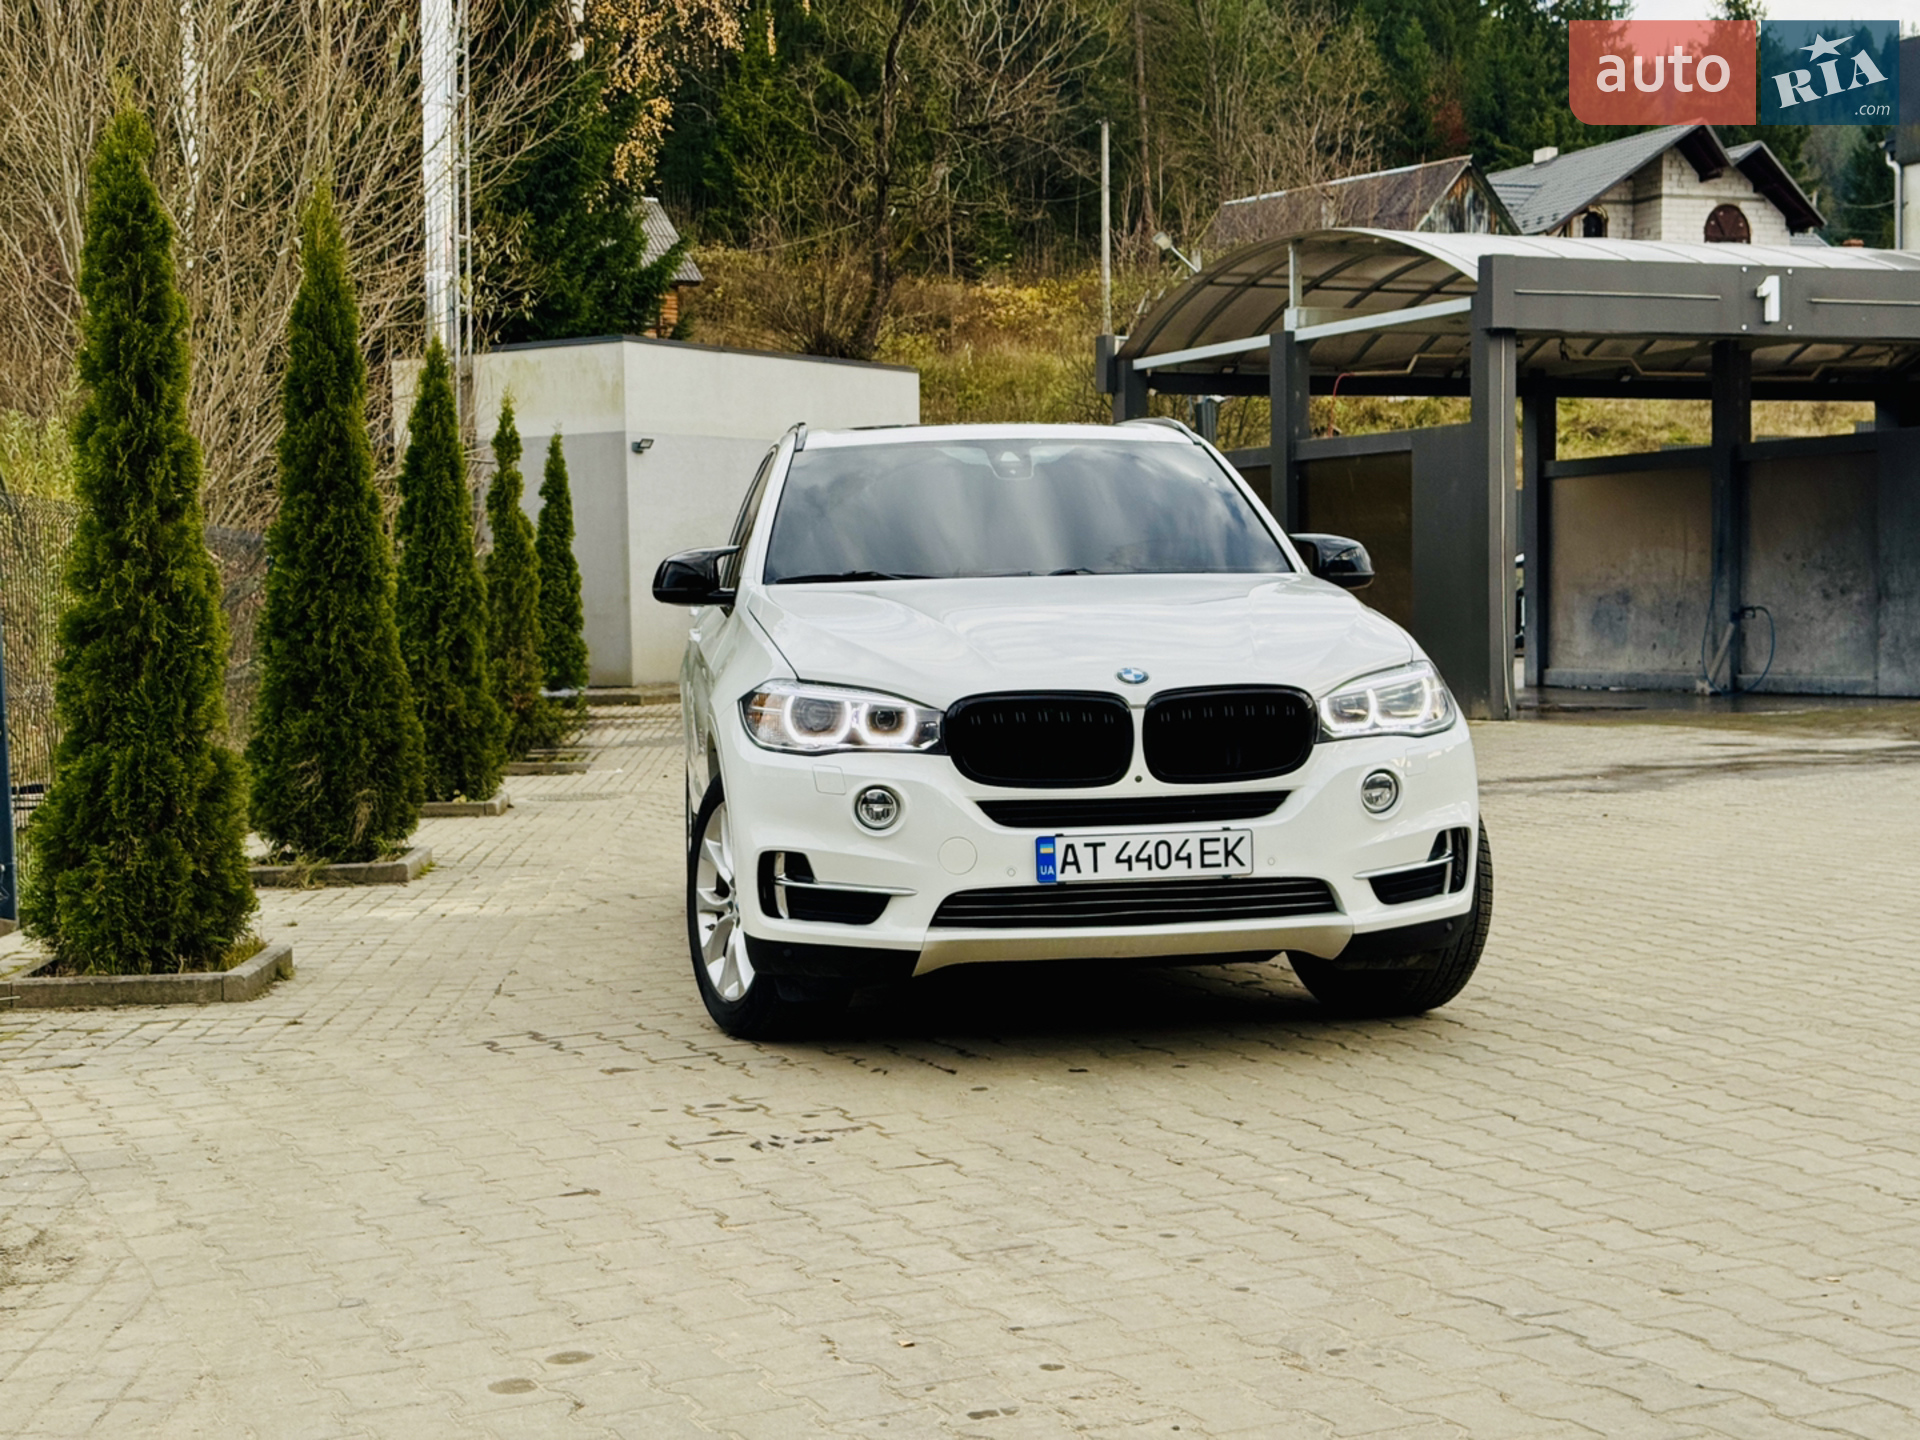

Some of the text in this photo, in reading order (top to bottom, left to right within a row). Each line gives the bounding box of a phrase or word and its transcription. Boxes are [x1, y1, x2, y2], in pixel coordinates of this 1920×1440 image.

[1756, 275, 1780, 323] 1
[1040, 865, 1055, 876] UA
[1060, 836, 1246, 874] AT 4404 EK
